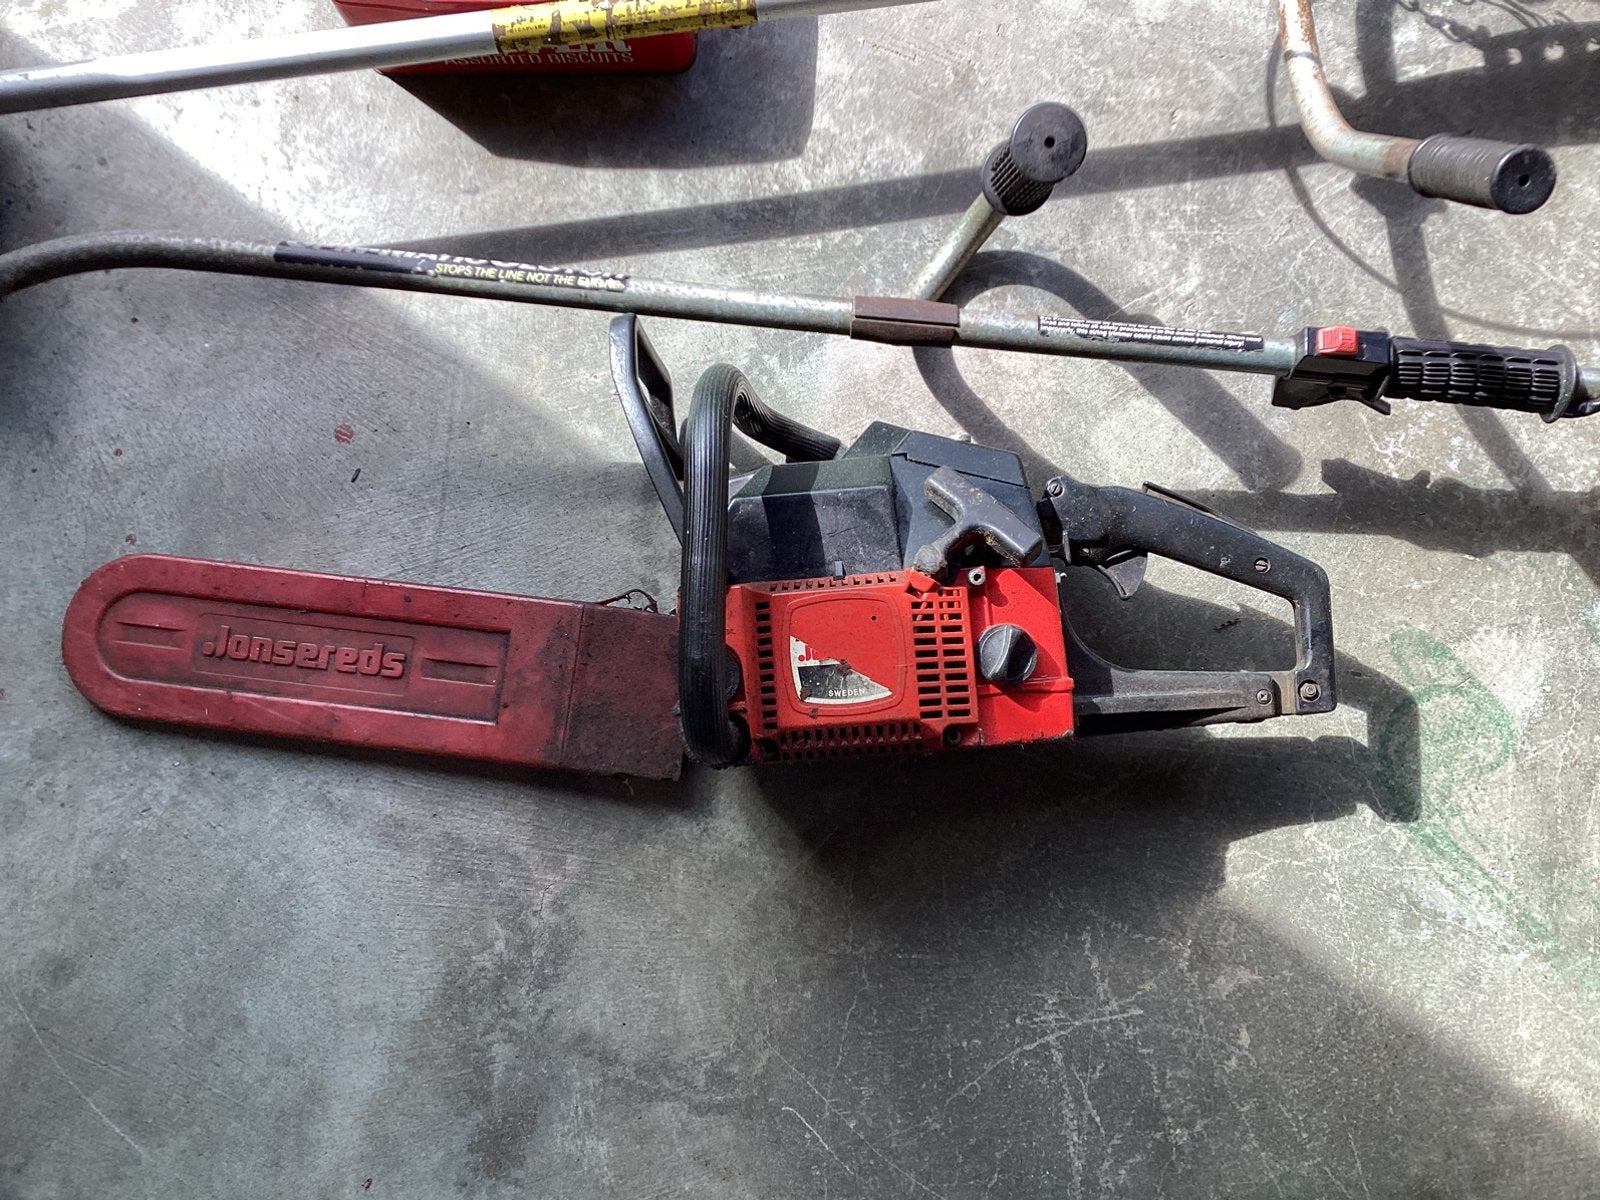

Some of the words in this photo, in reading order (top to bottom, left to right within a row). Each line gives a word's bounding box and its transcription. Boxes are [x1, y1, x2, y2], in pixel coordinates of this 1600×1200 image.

[547, 52, 634, 63] BISCUITS
[434, 262, 474, 277] STOPS
[474, 266, 498, 279] THE
[498, 268, 526, 281] LINE
[526, 271, 552, 283] NOT
[553, 273, 577, 286] THE
[1100, 324, 1119, 332] safety
[1133, 331, 1152, 339] could
[1196, 337, 1224, 345] personal
[828, 688, 865, 697] SWEDEN
